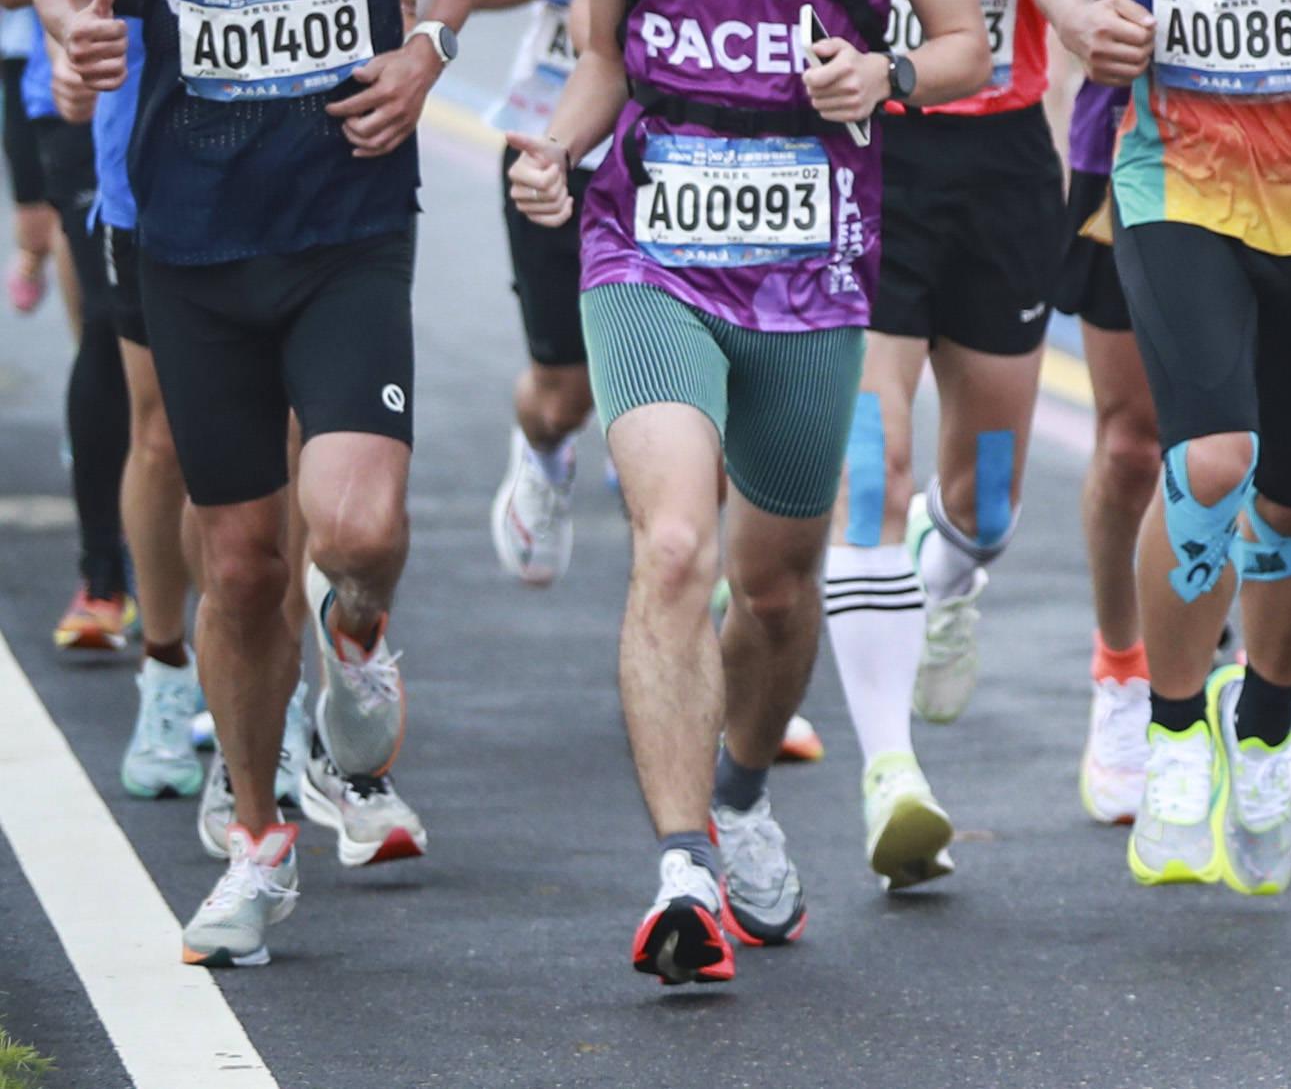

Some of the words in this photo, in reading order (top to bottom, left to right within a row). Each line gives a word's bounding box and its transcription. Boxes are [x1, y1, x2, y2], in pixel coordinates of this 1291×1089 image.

[193, 5, 359, 70] A01408
[802, 167, 820, 180] 02
[647, 181, 818, 232] A00993
